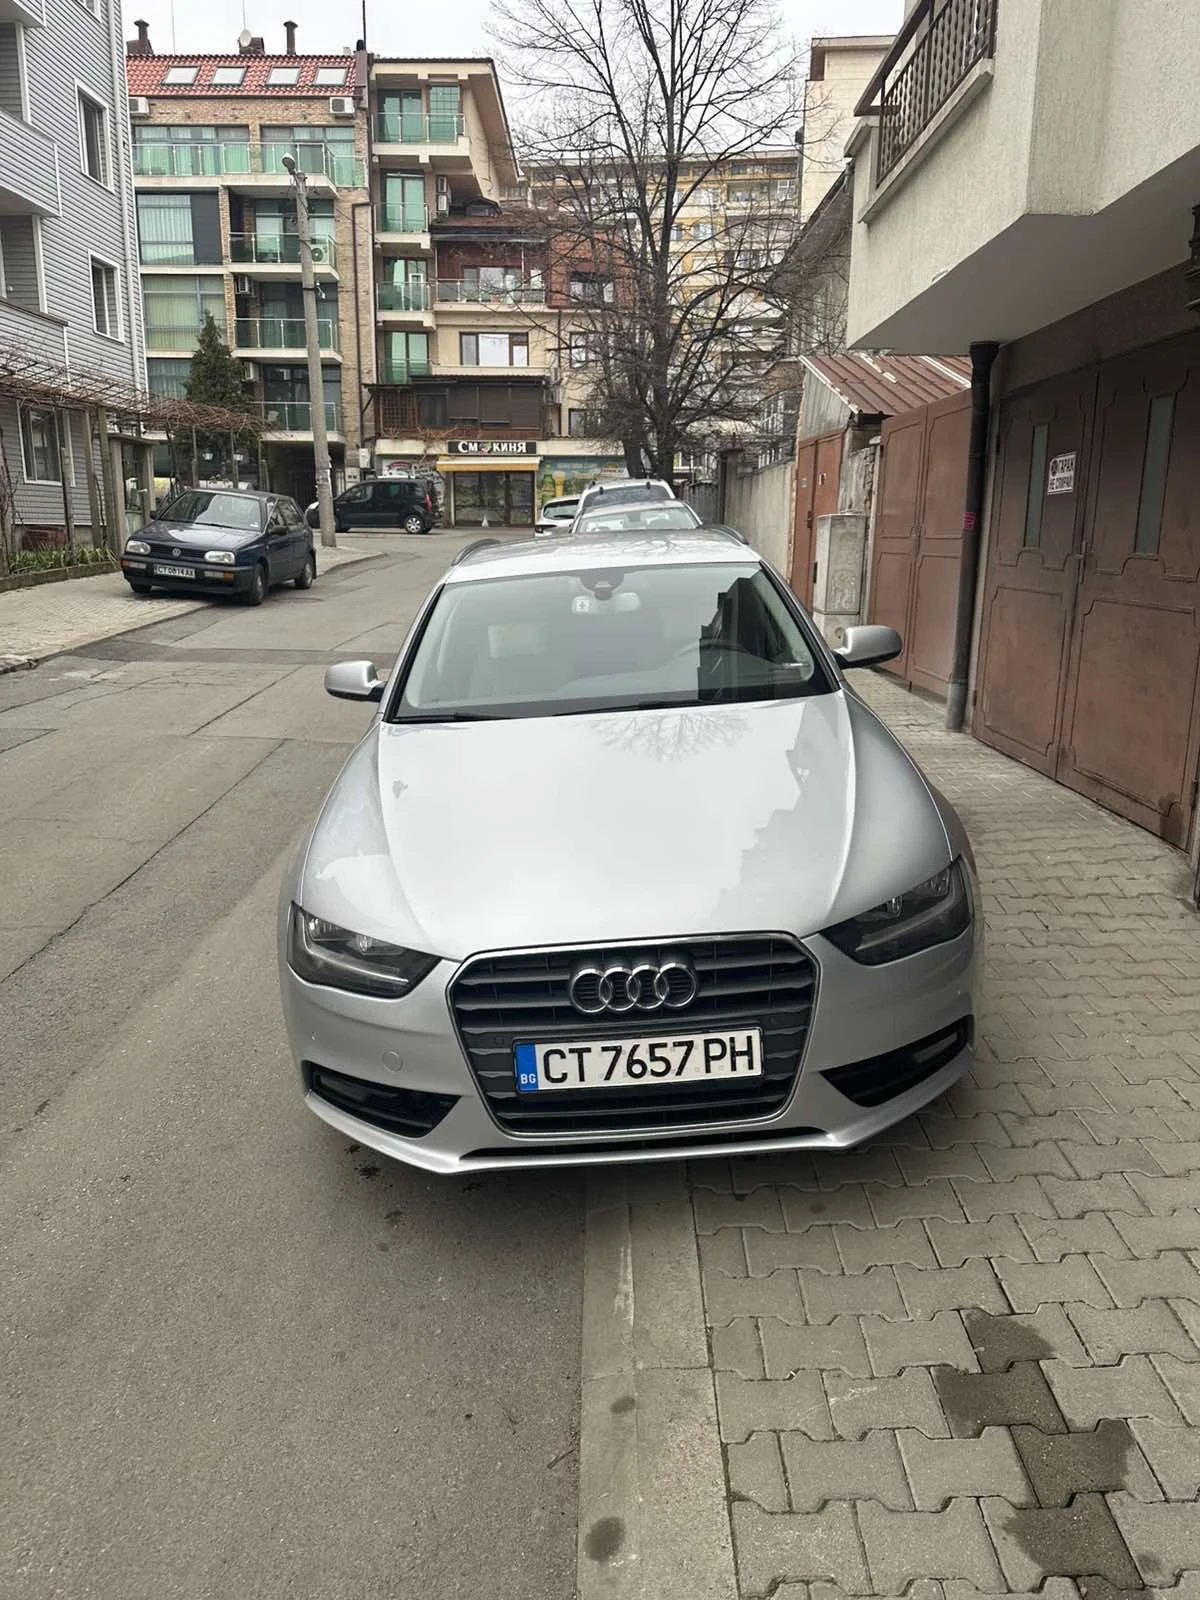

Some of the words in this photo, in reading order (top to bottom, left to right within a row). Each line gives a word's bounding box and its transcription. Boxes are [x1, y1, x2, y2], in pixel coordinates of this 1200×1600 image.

[543, 1047, 592, 1084] CT
[601, 1040, 694, 1081] 7657
[703, 1035, 754, 1074] PH
[520, 1073, 536, 1084] BG
